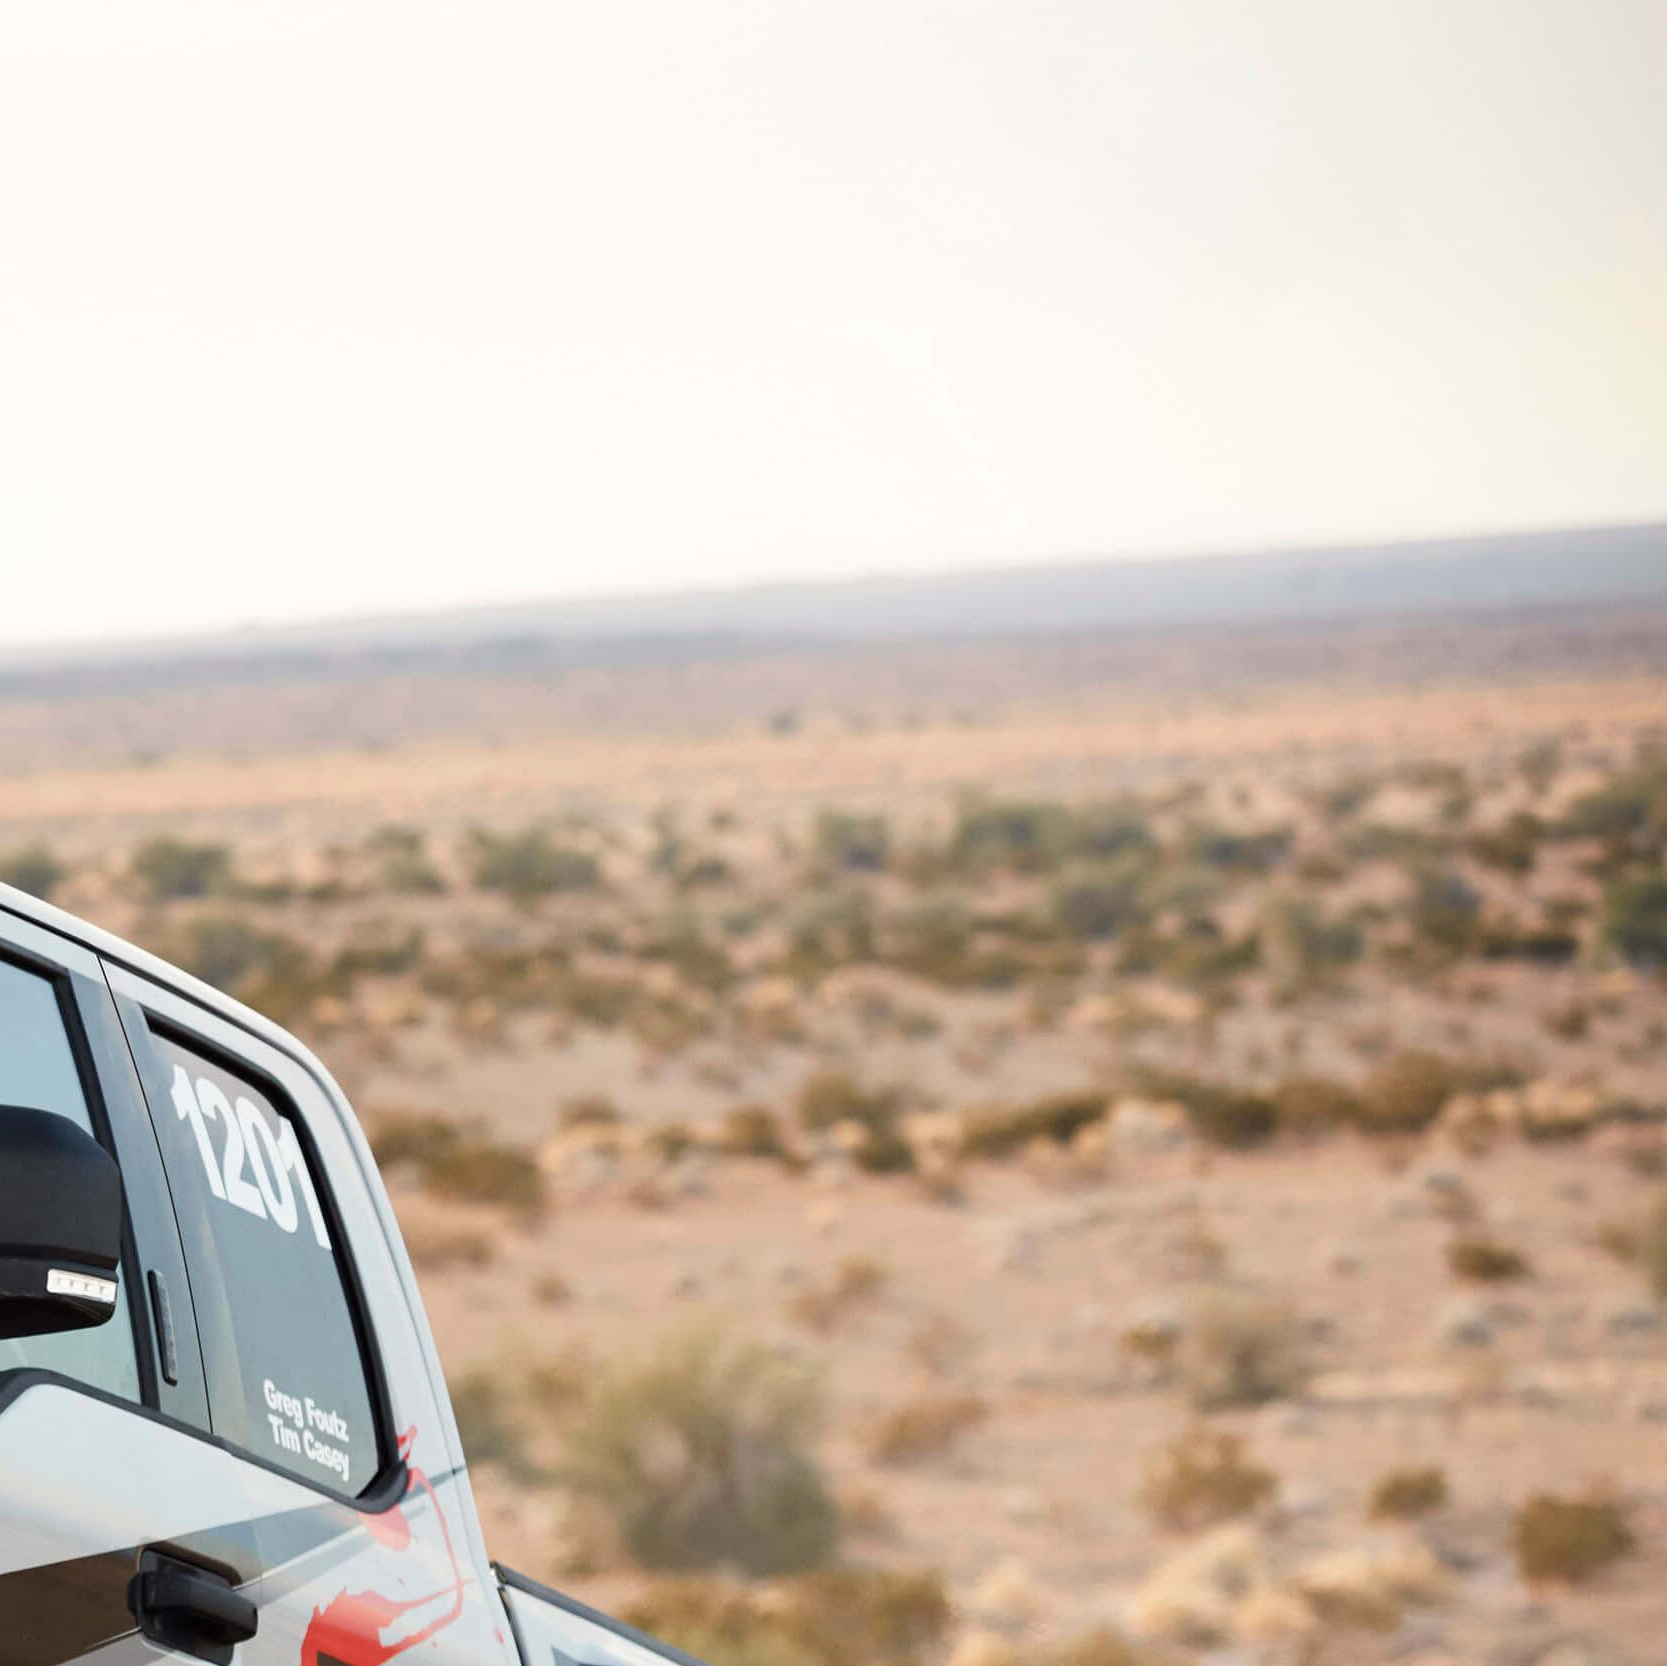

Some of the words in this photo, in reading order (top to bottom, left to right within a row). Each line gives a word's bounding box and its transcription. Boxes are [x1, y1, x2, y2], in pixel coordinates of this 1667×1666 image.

[170, 1063, 332, 1251] 1201
[263, 1378, 304, 1430] Greg
[303, 1396, 350, 1443] Foutz
[267, 1413, 302, 1454] Tim
[303, 1430, 350, 1482] Casey
